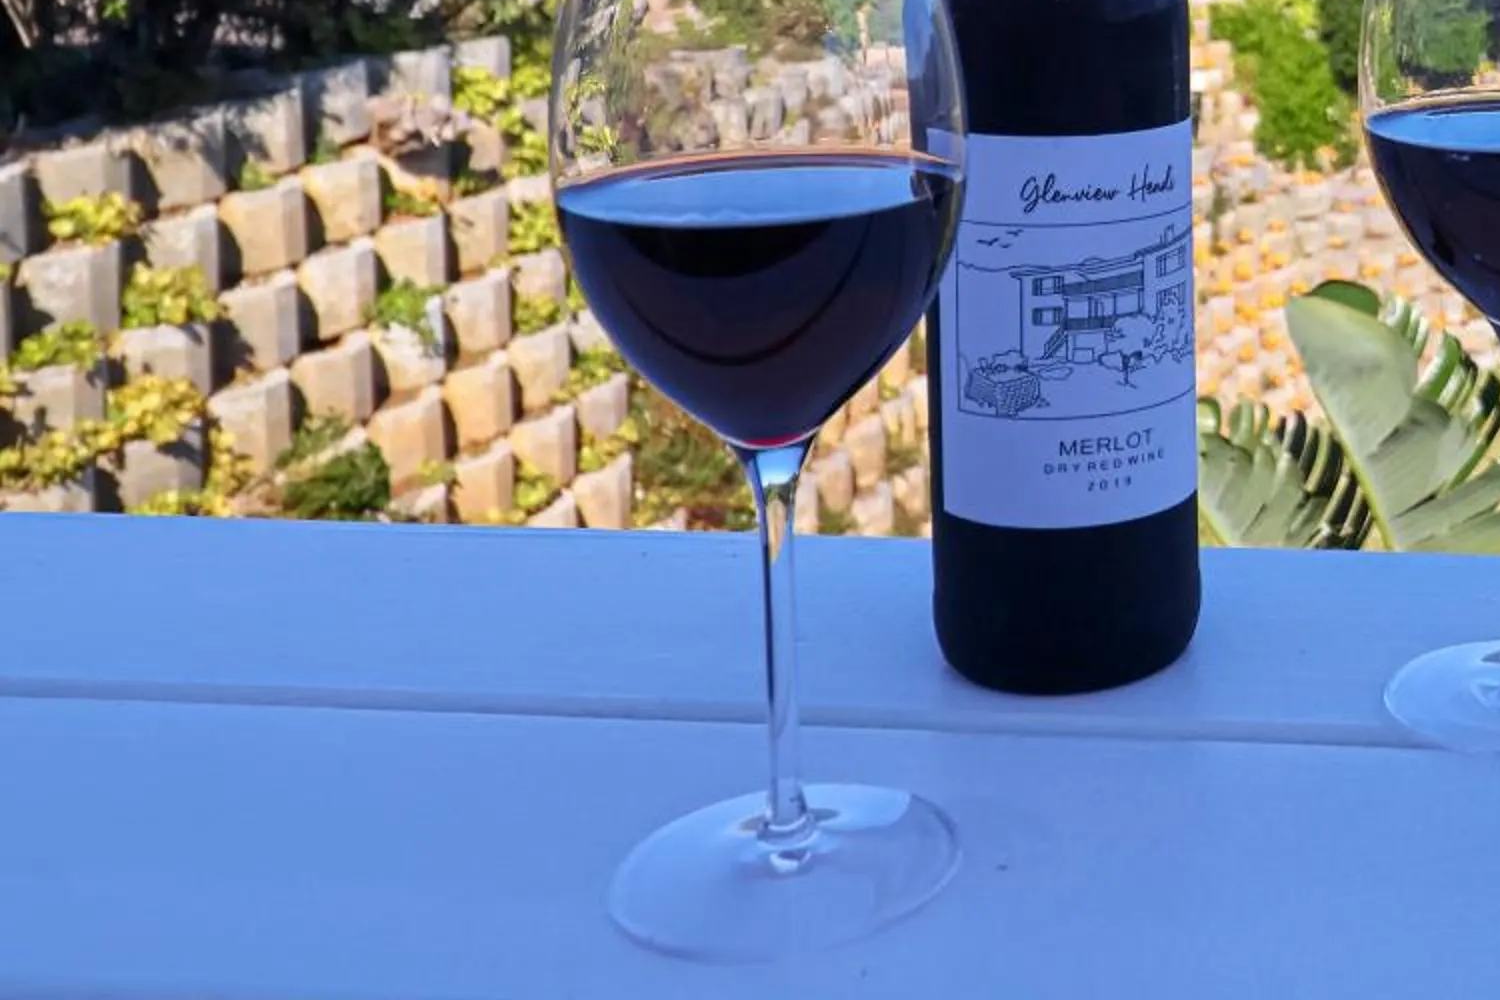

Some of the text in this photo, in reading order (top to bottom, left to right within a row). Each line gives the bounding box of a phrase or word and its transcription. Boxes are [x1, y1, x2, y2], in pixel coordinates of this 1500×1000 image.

[1020, 172, 1119, 213] Glenview
[1059, 427, 1153, 457] MERLOT
[1043, 447, 1165, 475] DRY RED WINE
